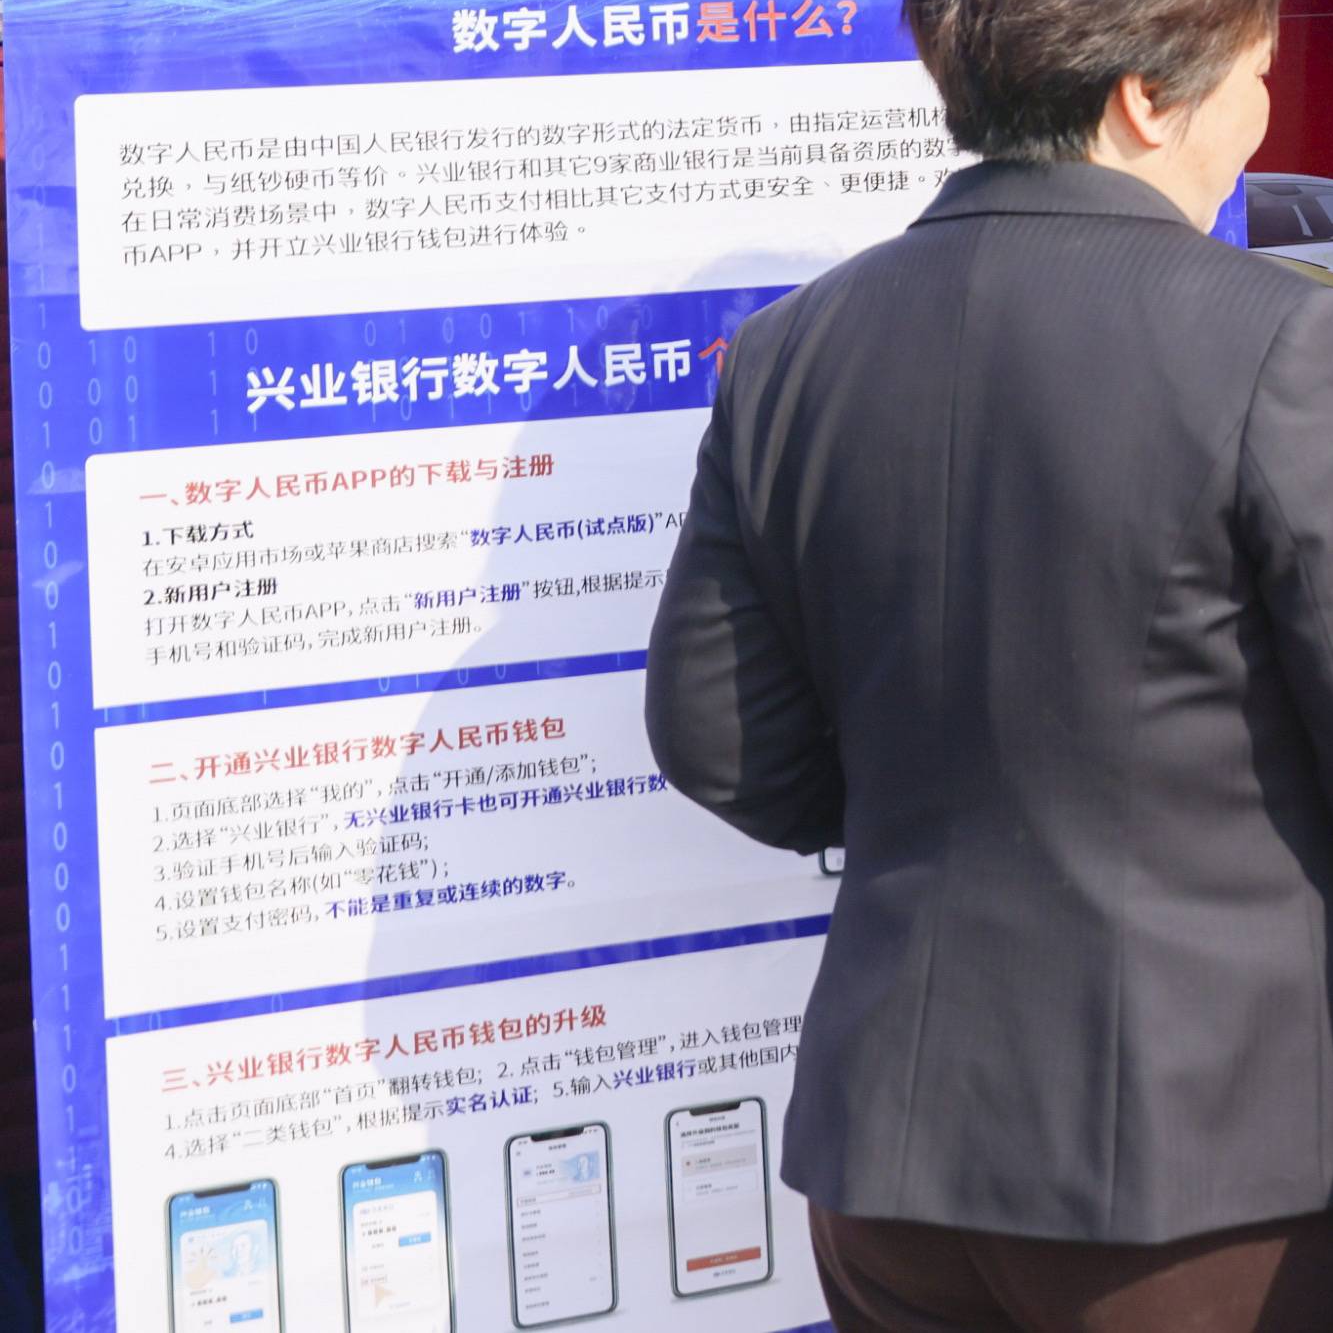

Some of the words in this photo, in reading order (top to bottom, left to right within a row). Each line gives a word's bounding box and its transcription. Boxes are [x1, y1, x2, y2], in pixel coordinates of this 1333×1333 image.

[139, 454, 555, 506] 一、数字人民币APP的下载与注册
[141, 520, 254, 547] 1.下载方式
[143, 577, 277, 606] 2.新用户注册
[149, 717, 567, 784] 二、开通兴业银行数字人民币钱包
[162, 1004, 607, 1092] 三、兴业银行数字人民币钱包的升级
